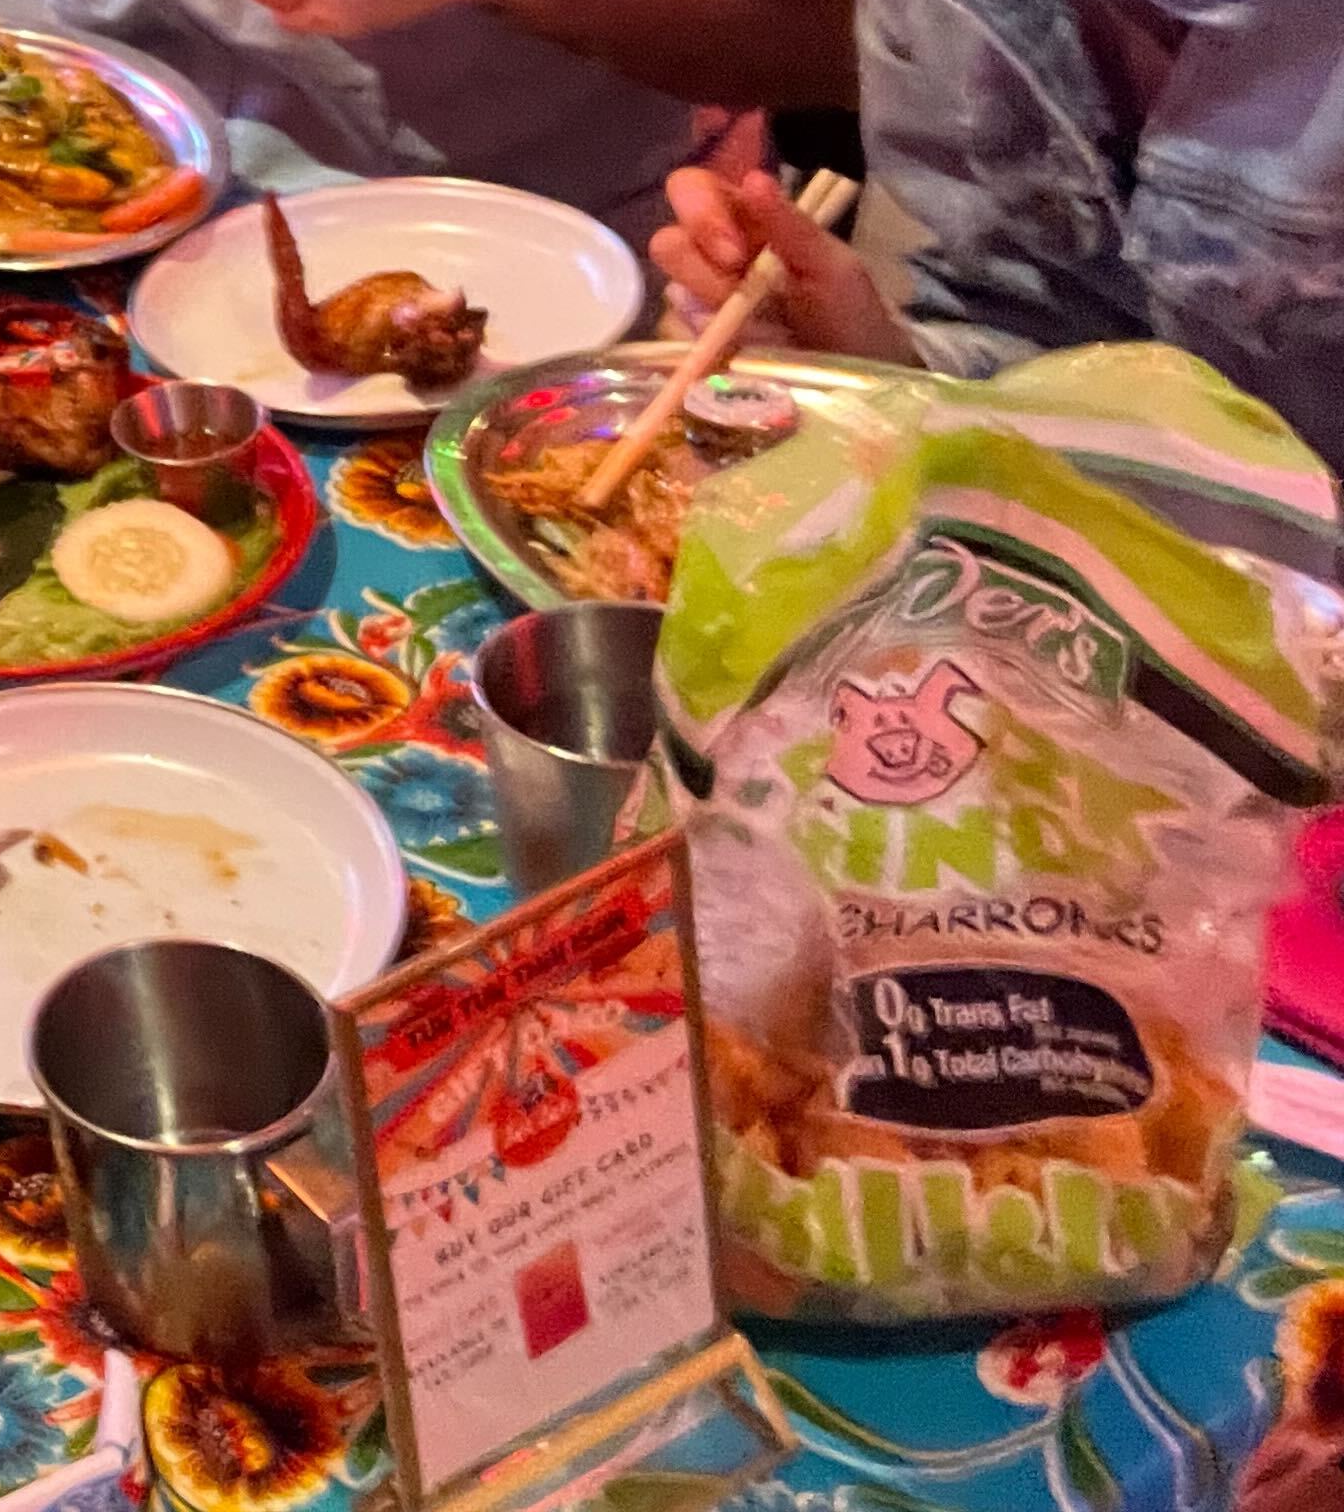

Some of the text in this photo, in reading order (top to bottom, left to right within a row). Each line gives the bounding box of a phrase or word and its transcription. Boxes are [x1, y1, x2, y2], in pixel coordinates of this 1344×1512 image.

[928, 996, 1007, 1030] Trans
[1009, 992, 1053, 1023] Fat
[936, 1049, 999, 1082] Total
[434, 1230, 477, 1266] BUY
[488, 1200, 531, 1235] OUR
[541, 1165, 589, 1205] GIFT
[596, 1131, 654, 1173] CARD
